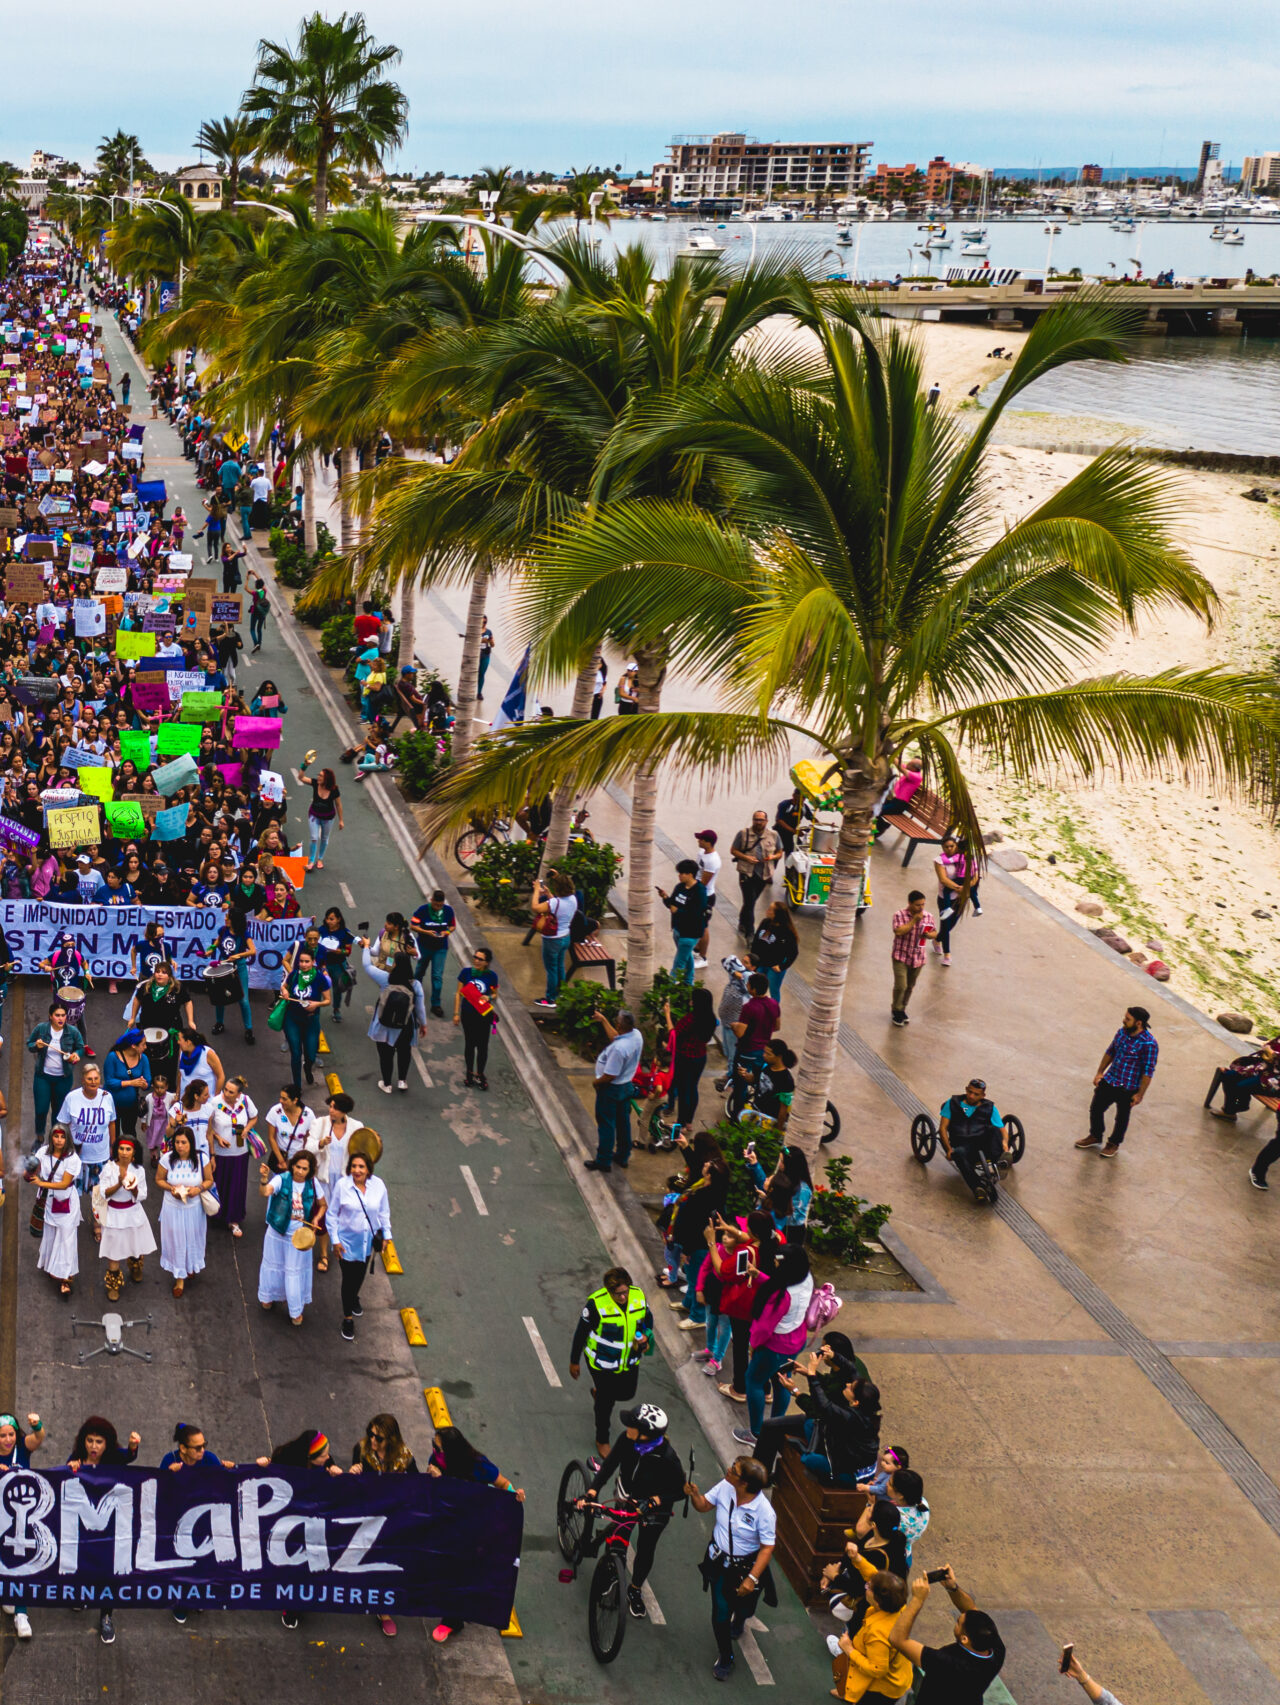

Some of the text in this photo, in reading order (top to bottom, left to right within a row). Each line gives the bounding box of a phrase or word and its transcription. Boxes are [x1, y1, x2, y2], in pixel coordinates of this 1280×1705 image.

[56, 828, 94, 841] JUSTICIA
[4, 904, 15, 923] E
[23, 904, 108, 926] IMPUNIDAD
[116, 908, 147, 927] DEL
[155, 911, 216, 931] ESTADO
[77, 1107, 105, 1126] ALTO
[75, 1131, 104, 1144] VIOLENCIA
[230, 1582, 263, 1600] DE
[276, 1584, 396, 1606] MUJERES
